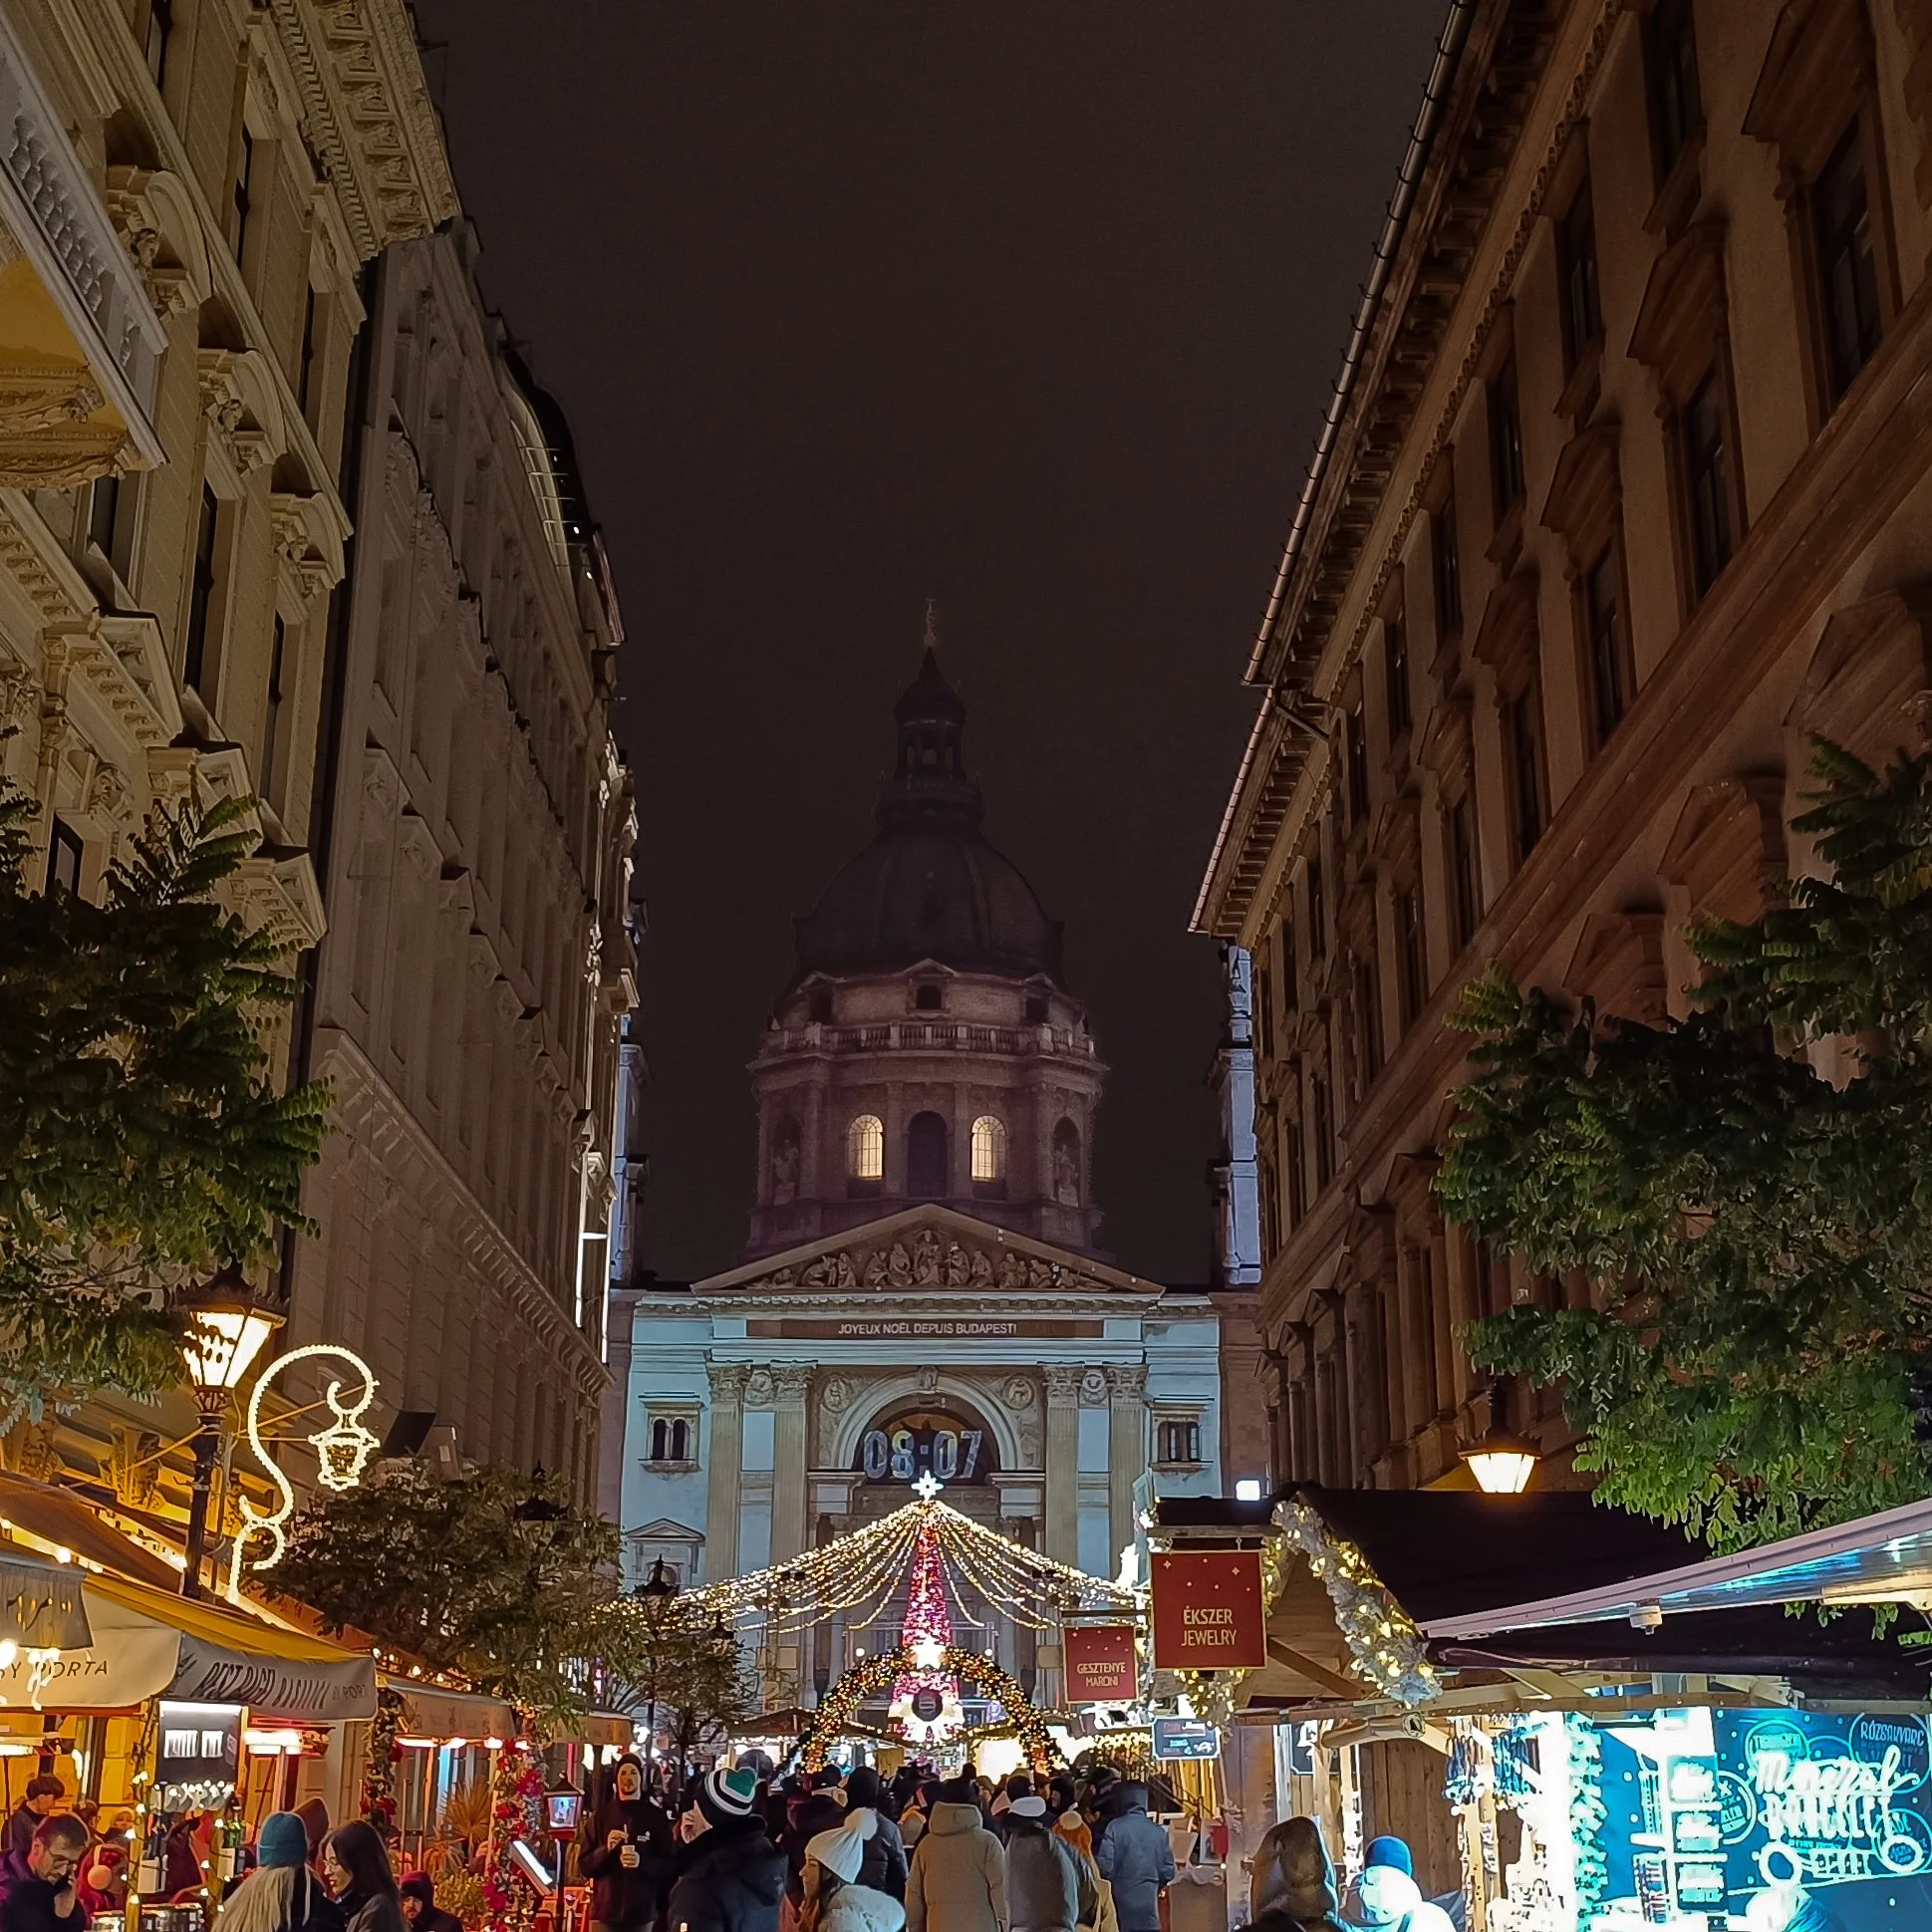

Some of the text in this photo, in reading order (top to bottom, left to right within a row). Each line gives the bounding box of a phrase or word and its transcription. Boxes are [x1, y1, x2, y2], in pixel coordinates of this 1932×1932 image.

[838, 1323, 881, 1335] JOYEUX
[914, 1322, 954, 1334] DEPUIS
[863, 1430, 982, 1480] 08:07
[1183, 1605, 1234, 1625] ÉKSZER
[1181, 1629, 1238, 1646] JEWELRY
[1076, 1662, 1127, 1674] GESZTENYE
[1085, 1676, 1119, 1687] MARONI
